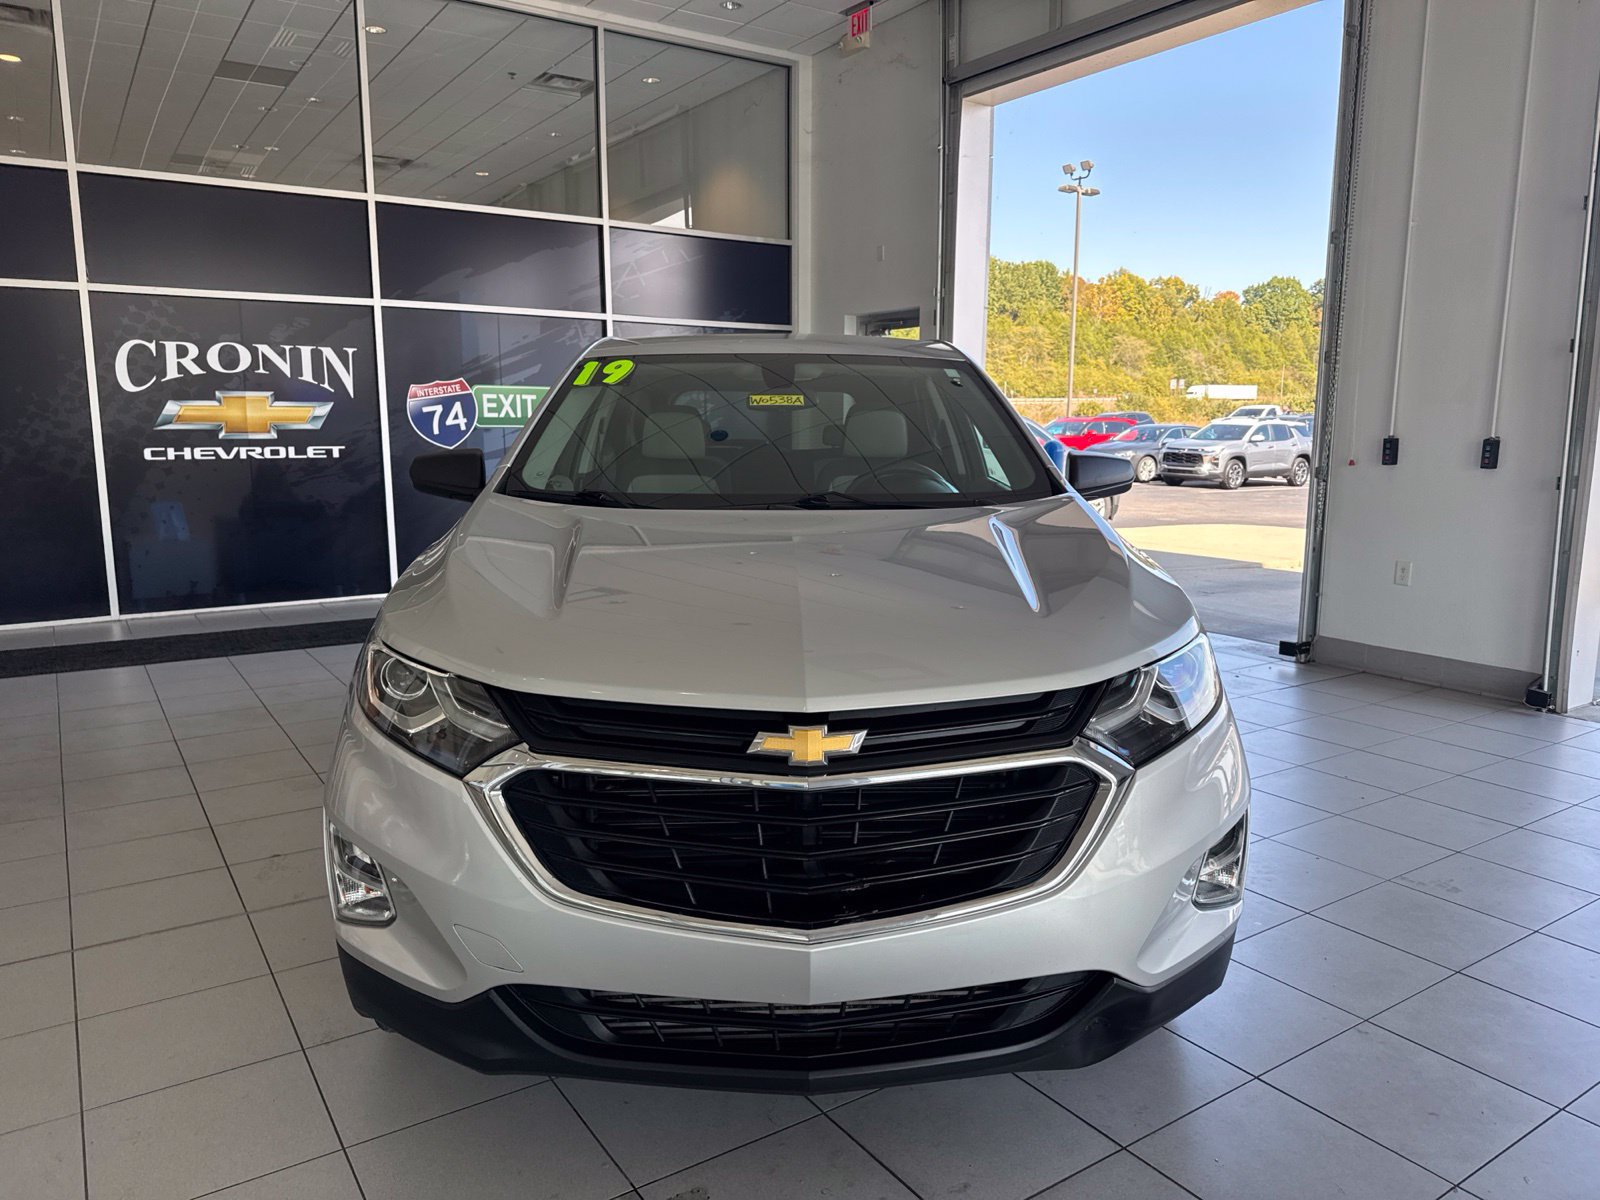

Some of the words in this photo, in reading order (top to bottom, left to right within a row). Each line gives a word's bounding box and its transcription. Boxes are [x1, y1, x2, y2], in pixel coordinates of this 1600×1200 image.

[851, 8, 869, 37] EXIT
[115, 339, 357, 399] CRONIN
[573, 359, 635, 386] 19
[416, 383, 462, 397] INTERSTATE
[422, 401, 468, 435] 74
[482, 394, 537, 418] EXIT
[143, 445, 346, 461] CHEVROLET
